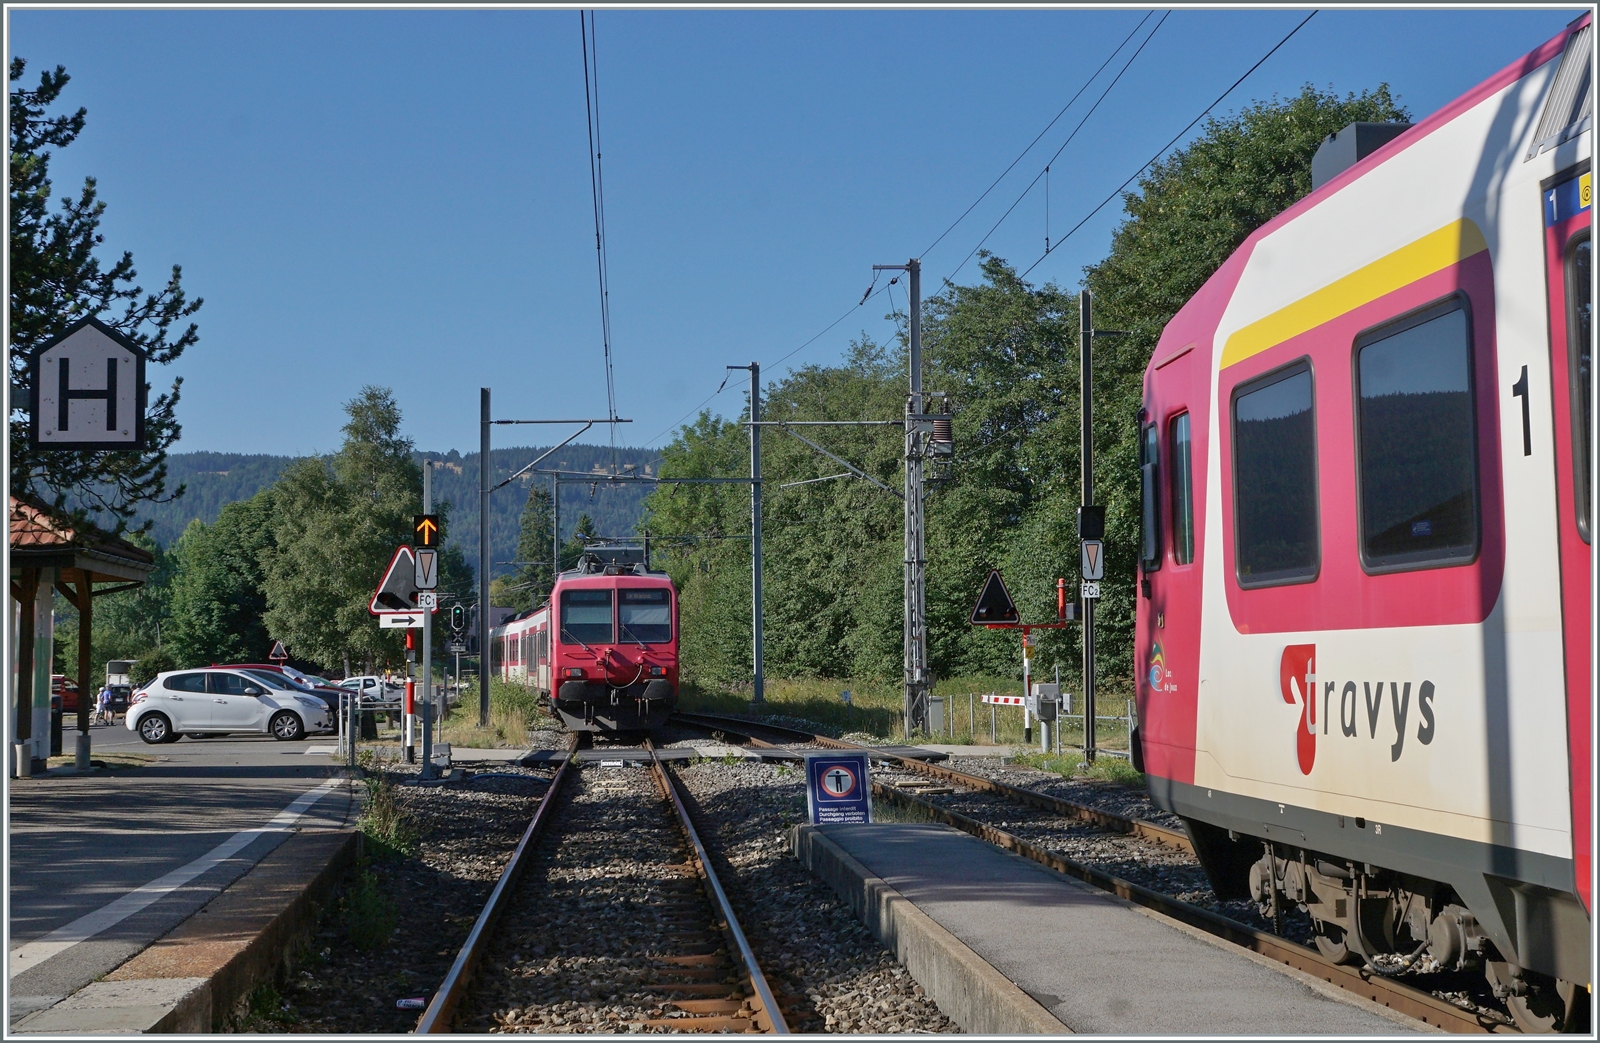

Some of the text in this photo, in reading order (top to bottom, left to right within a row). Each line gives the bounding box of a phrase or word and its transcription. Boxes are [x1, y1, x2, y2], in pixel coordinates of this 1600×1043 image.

[1549, 188, 1558, 221] 1
[58, 358, 117, 431] H
[1512, 364, 1532, 457] 1
[1082, 585, 1099, 596] FC2
[1303, 656, 1437, 763] travys
